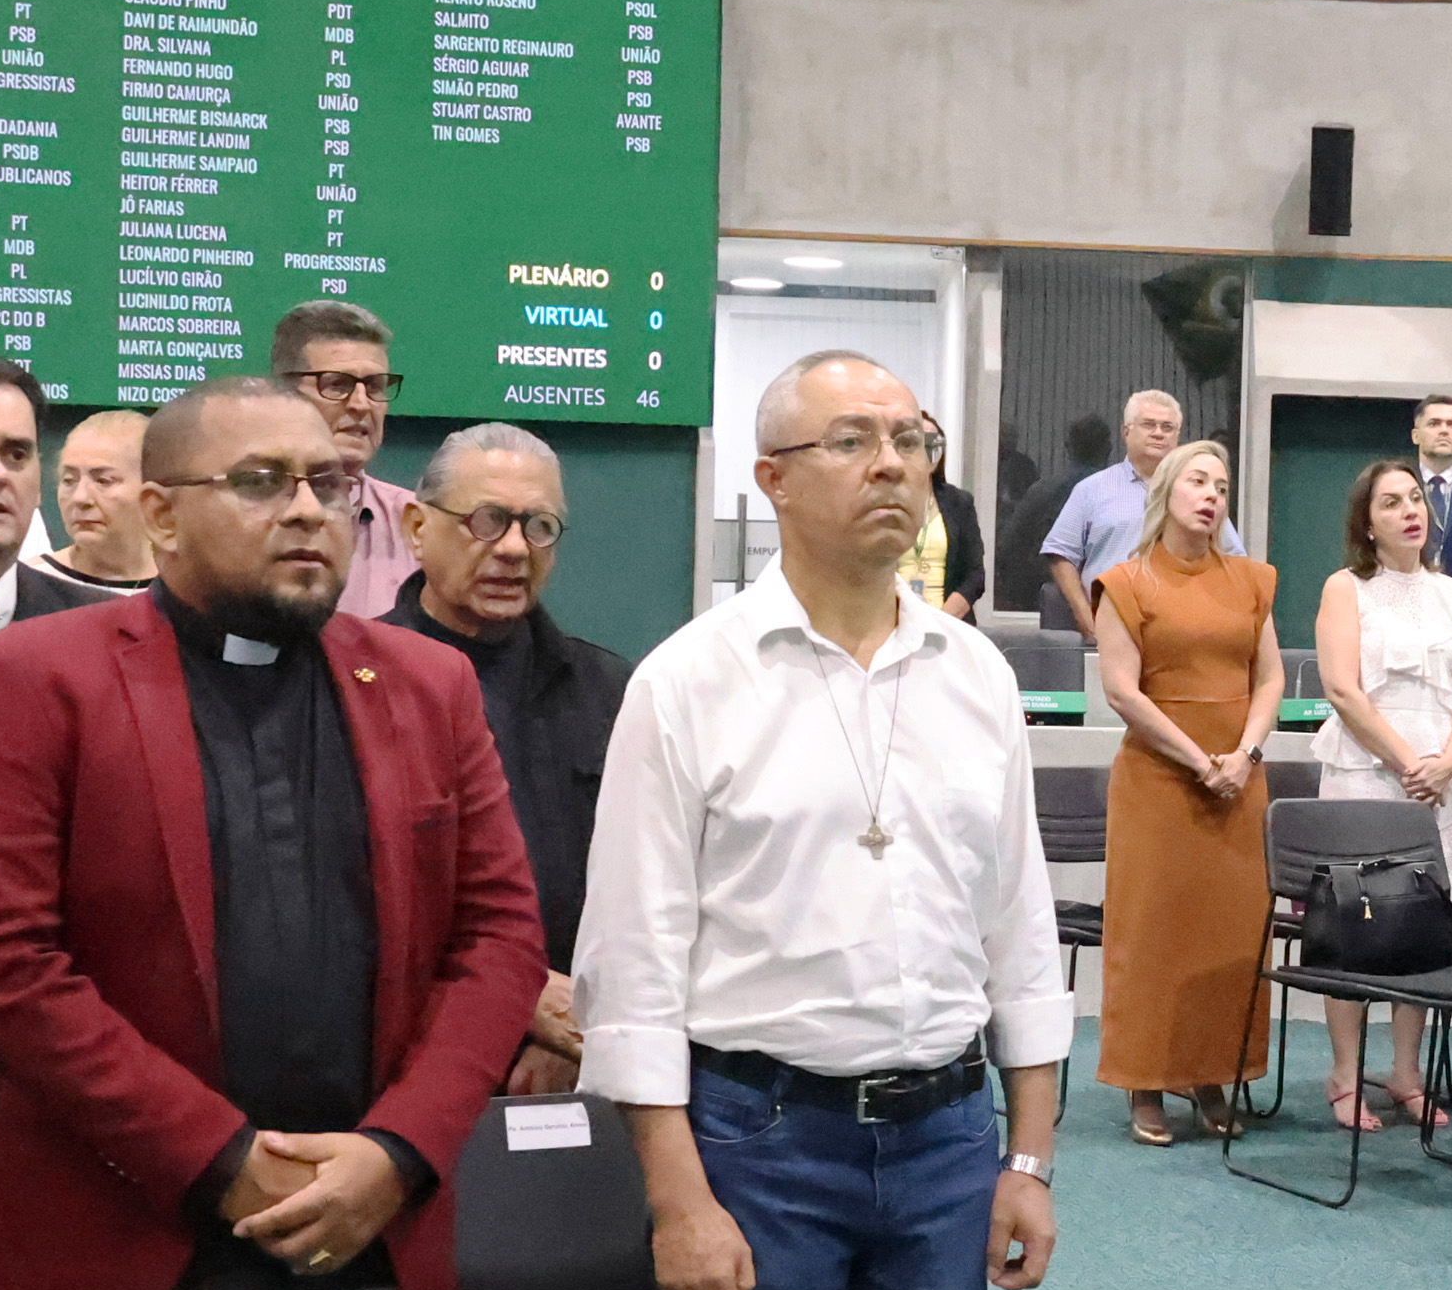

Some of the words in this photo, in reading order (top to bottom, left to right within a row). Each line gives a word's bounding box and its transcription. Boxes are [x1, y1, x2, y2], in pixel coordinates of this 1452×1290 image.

[15, 2, 32, 19] PT
[328, 4, 352, 19] PDT
[626, 1, 657, 18] PSOL
[124, 11, 154, 29] DAVI
[158, 14, 175, 30] DE
[178, 15, 257, 36] RAIMUNDÃO
[434, 11, 489, 29] SALMITO
[10, 26, 36, 43] PSB
[325, 27, 354, 43] MDB
[629, 25, 653, 40] PSB
[124, 35, 154, 52] DRA.
[157, 37, 211, 56] SILVANA
[434, 34, 499, 53] SARGENTO
[503, 39, 574, 58] REGINAURO
[2, 48, 44, 67] UNIÃO
[331, 50, 346, 65] PL
[621, 46, 660, 64] UNIÃO
[123, 58, 192, 77] FERNANDO
[195, 63, 233, 80] HUGO
[434, 53, 479, 74] SÉRGIO
[482, 60, 529, 77] AGUIAR
[326, 73, 351, 88] PSD
[628, 70, 652, 85] PSB
[123, 81, 163, 99] FIRMO
[167, 84, 231, 107] CAMURÇA
[433, 78, 473, 96] SIMÃO
[477, 82, 518, 99] PEDRO
[319, 93, 358, 111] UNIÃO
[627, 92, 651, 107] PSD
[122, 106, 197, 125] GUILHERME
[200, 110, 267, 129] BISMARCK
[433, 102, 481, 119] STUART
[483, 105, 531, 122] CASTRO
[325, 118, 350, 135] PSB
[616, 114, 662, 130] AVANTE
[122, 127, 197, 147] GUILHERME
[200, 132, 249, 149] LANDIM
[432, 125, 452, 140] TIN
[456, 126, 500, 143] GOMES
[3, 143, 39, 160] PSDB
[324, 140, 349, 156] PSB
[626, 137, 650, 152] PSB
[121, 151, 196, 170] GUILHERME
[199, 156, 257, 174] SAMPAIO
[329, 163, 345, 179] PT
[121, 174, 167, 191] HEITOR
[171, 173, 218, 194] FÉRRER
[317, 184, 356, 202] UNIÃO
[120, 194, 135, 213] JÔ
[139, 199, 184, 216] FARIAS
[12, 215, 28, 231] PT
[328, 209, 344, 224] PT
[120, 221, 173, 238] JULIANA
[177, 224, 227, 241] LUCENA
[328, 232, 343, 247] PT
[4, 239, 34, 255] MDB
[120, 245, 189, 263] LEONARDO
[193, 248, 253, 266] PINHEIRO
[11, 263, 27, 279] PL
[284, 253, 386, 273] PROGRESSISTAS
[120, 266, 178, 286] LUCÍLVIO
[182, 270, 222, 288] GIRÃO
[509, 263, 609, 288] PLENÁRIO
[650, 272, 663, 290] 0
[322, 278, 346, 294] PSD
[119, 293, 189, 310] LUCINILDO
[192, 296, 232, 312] FROTA
[14, 311, 32, 327] DO
[36, 312, 45, 327] B
[119, 315, 174, 332] MARCOS
[177, 318, 241, 335] SOBREIRA
[525, 306, 608, 327] VIRTUAL
[650, 312, 662, 329] 0
[5, 334, 31, 350] PSB
[119, 339, 163, 356] MARTA
[167, 341, 243, 361] GONÇALVES
[498, 345, 607, 368] PRESENTES
[649, 352, 661, 370] 0
[119, 363, 172, 380] MISSIAS
[175, 365, 205, 381] DIAS
[118, 386, 149, 402] NIZO
[504, 385, 605, 405] AUSENTES
[636, 390, 660, 407] 46
